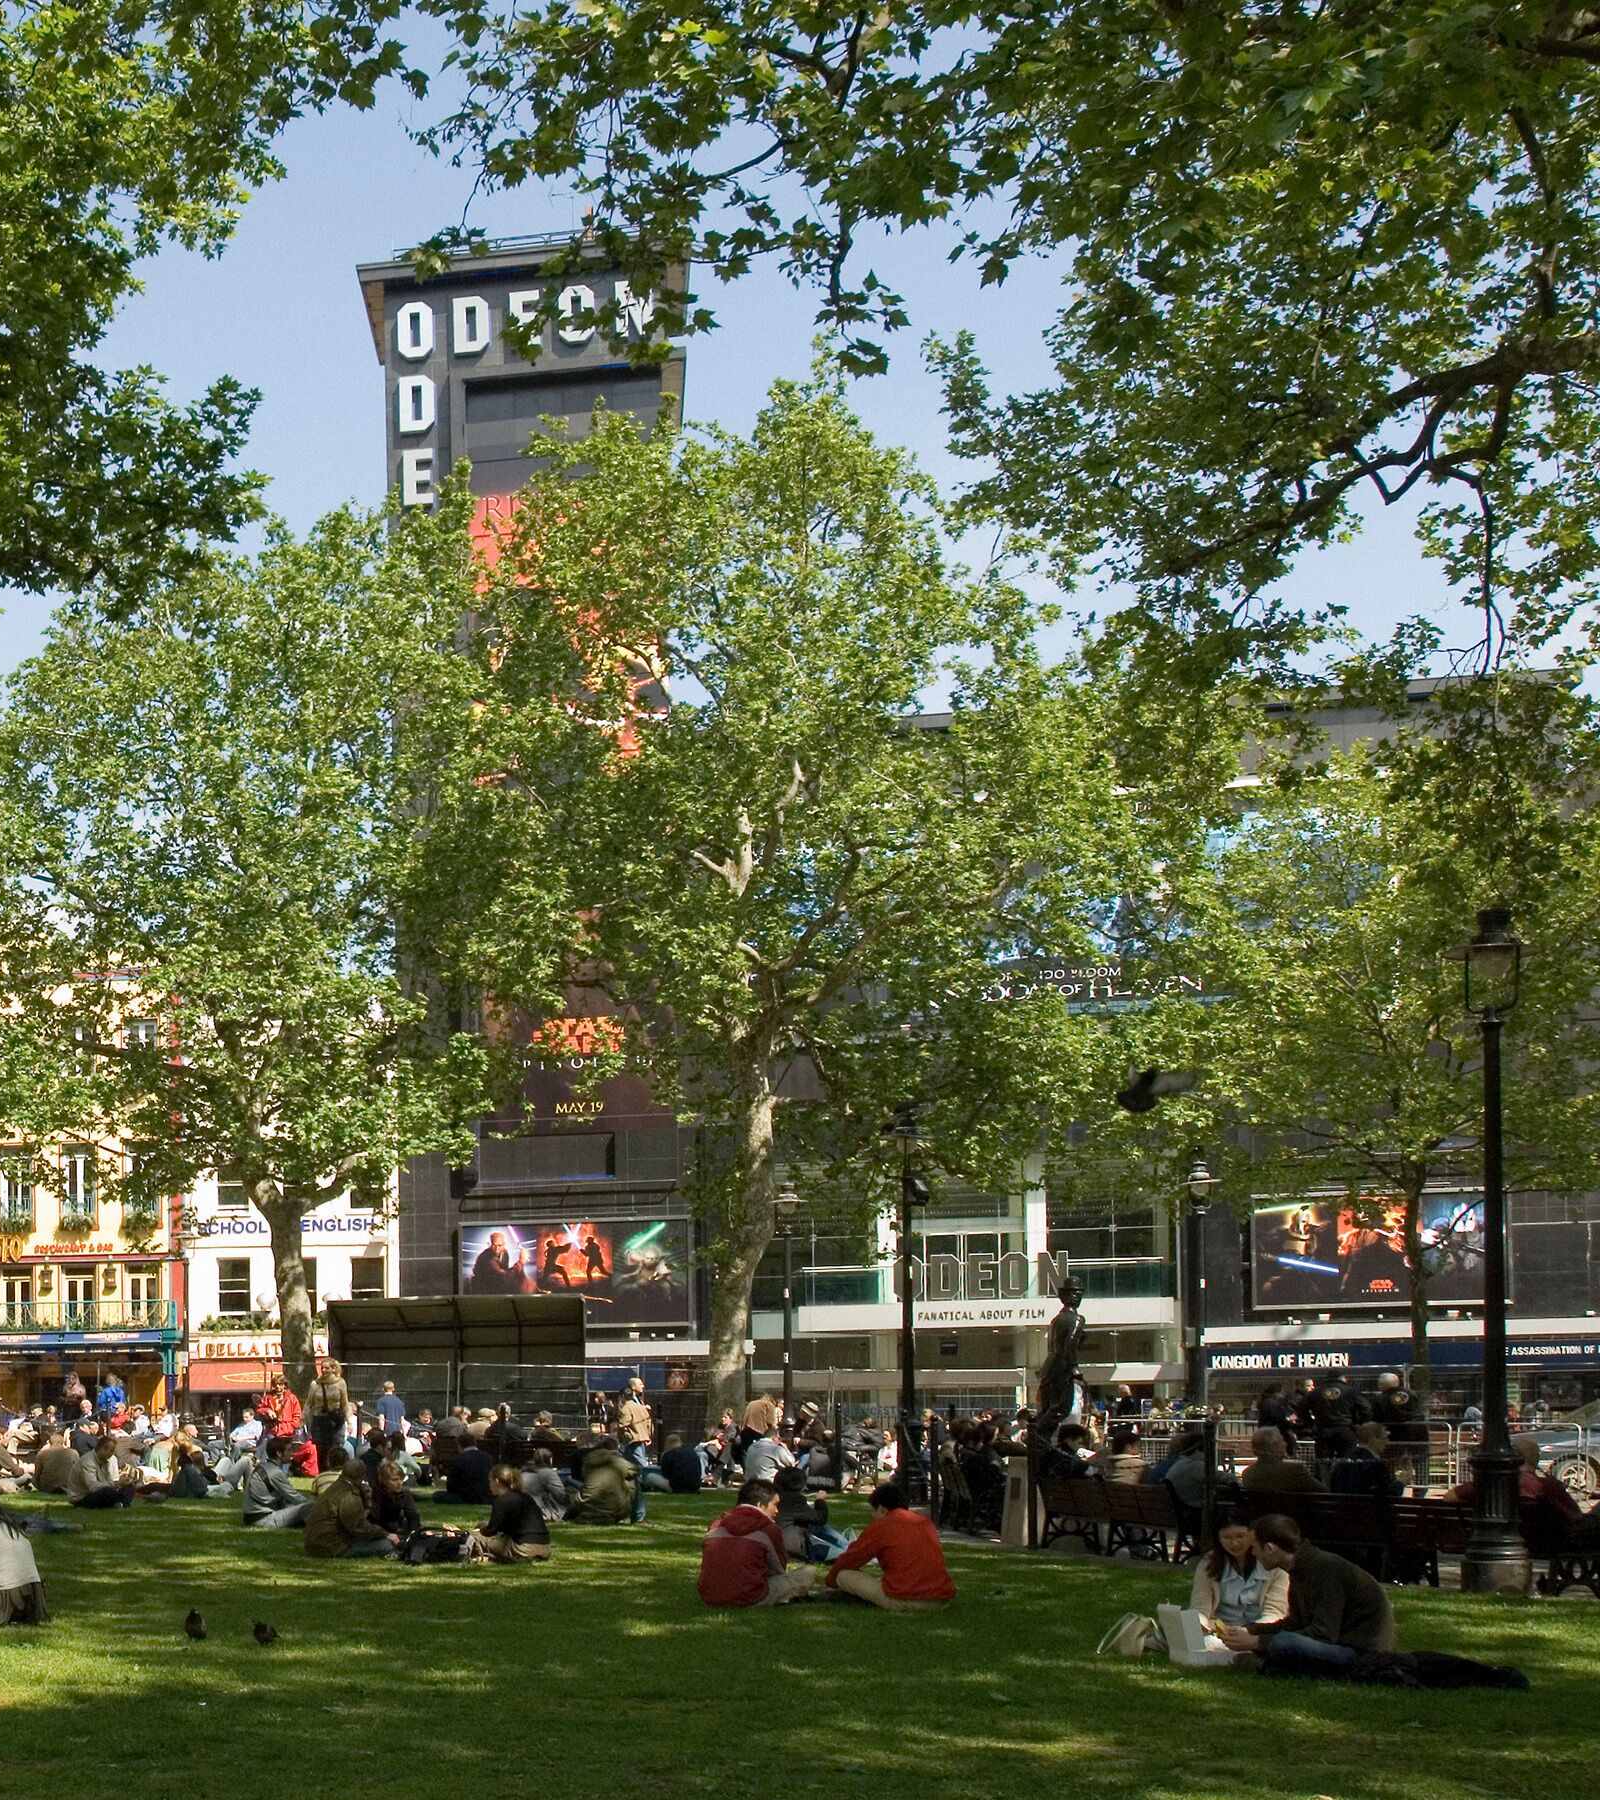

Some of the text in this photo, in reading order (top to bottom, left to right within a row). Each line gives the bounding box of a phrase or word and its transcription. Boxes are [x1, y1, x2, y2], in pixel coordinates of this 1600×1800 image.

[1058, 983, 1083, 996] OF
[555, 1102, 604, 1114] MAY 19
[197, 1221, 268, 1236] SCHOOL
[301, 1218, 375, 1232] ENGLISH
[893, 1251, 1068, 1299] ODEON
[918, 1307, 1045, 1321] FANATICAL ABOUT FILM
[205, 1342, 259, 1357] BELLA
[1511, 1346, 1581, 1356] ASSASSINATION
[1584, 1345, 1596, 1354] OF
[1212, 1352, 1349, 1368] KINGDOM OF HEAVEN
